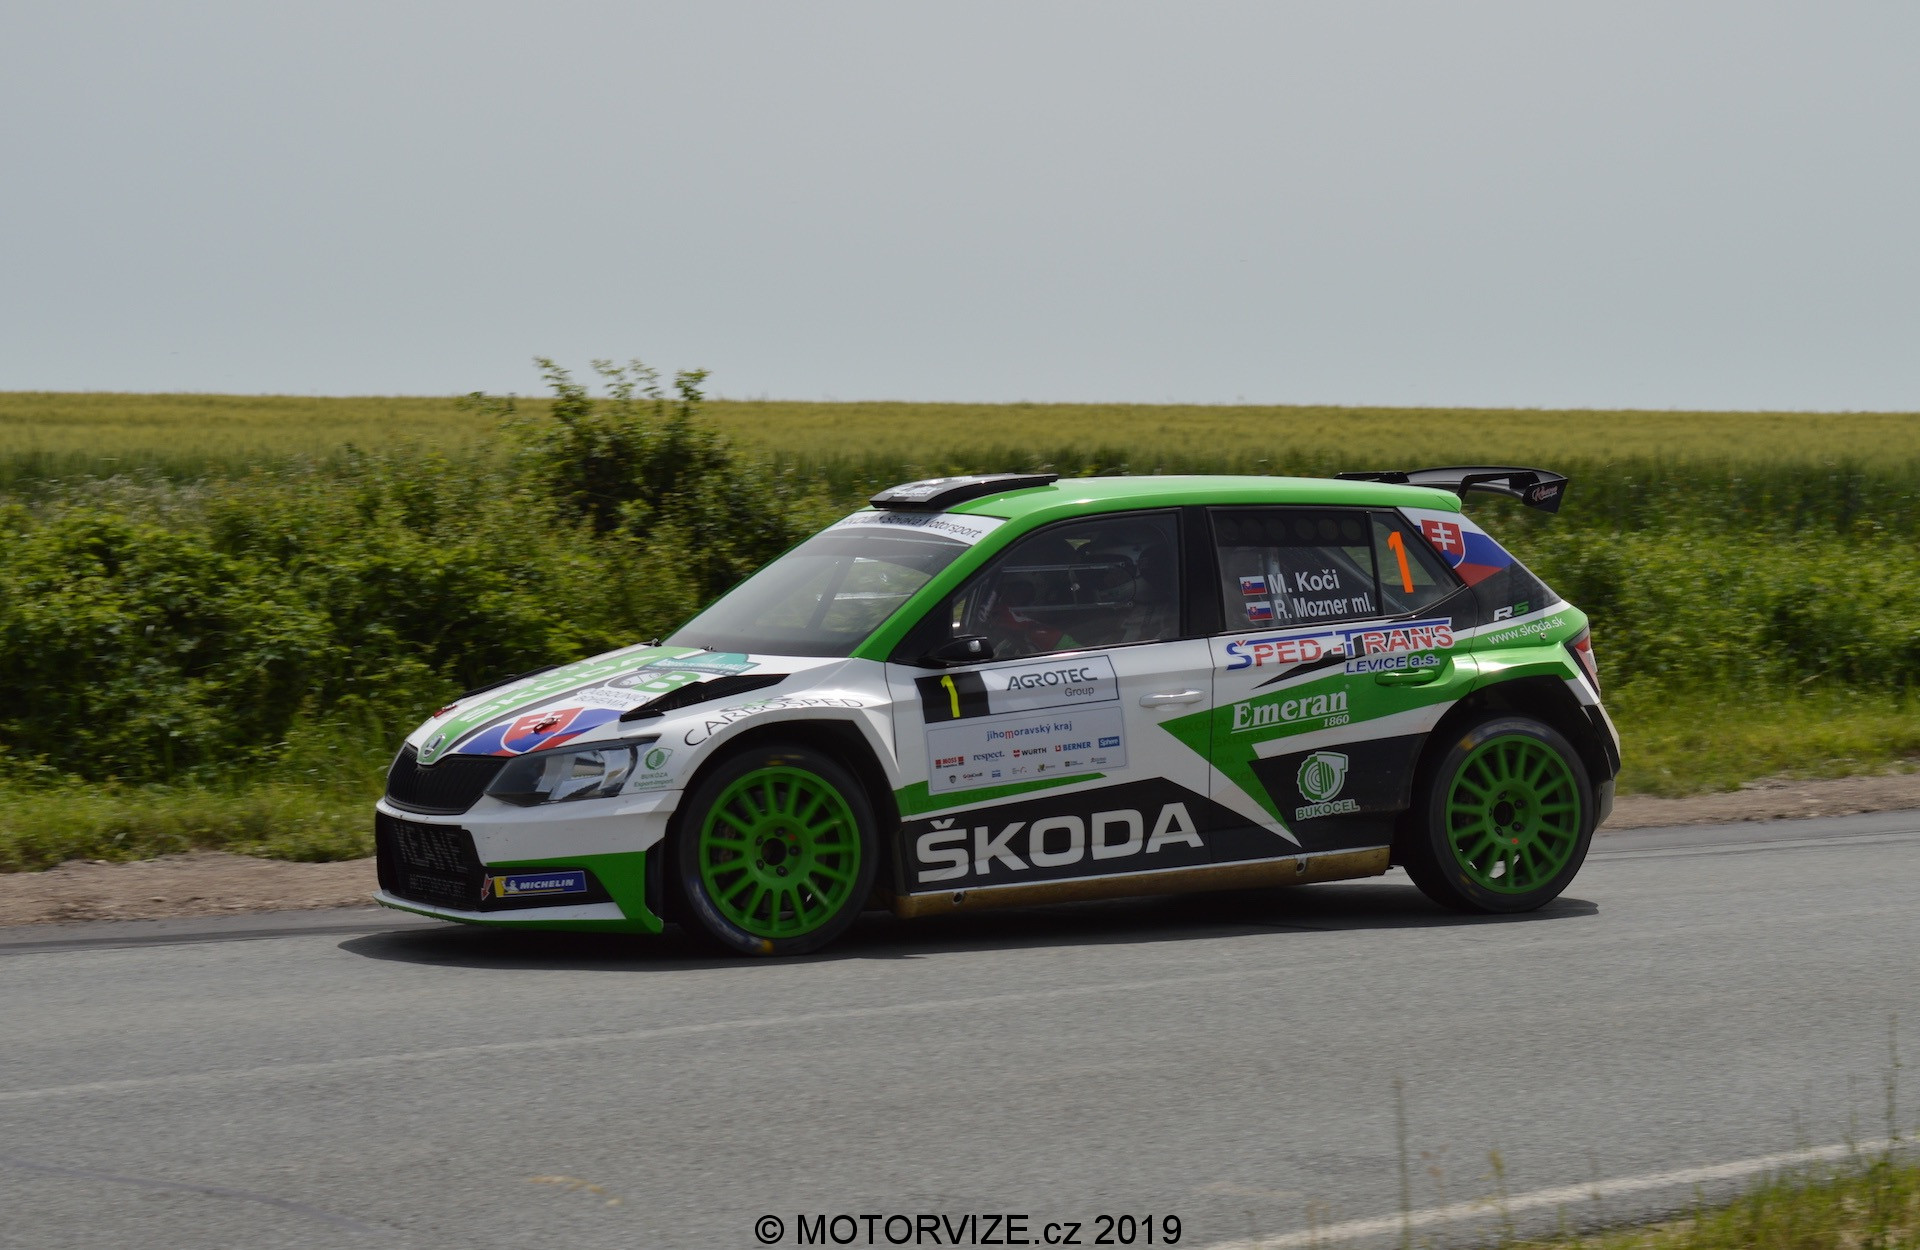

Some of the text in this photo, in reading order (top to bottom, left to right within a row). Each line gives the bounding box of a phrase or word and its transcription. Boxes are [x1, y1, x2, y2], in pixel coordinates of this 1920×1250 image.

[1387, 531, 1414, 594] 1
[1268, 569, 1340, 594] M. Koči
[1275, 592, 1376, 619] R. Mozner ml.
[1487, 616, 1566, 645] www.skoda.sk
[1346, 654, 1439, 674] LEVICE a.s.
[1006, 667, 1098, 691] AGROTEC
[940, 674, 961, 718] 1
[1064, 685, 1095, 698] Group
[684, 697, 864, 747] CARBOSPED
[1232, 690, 1349, 731] Emeran
[1323, 714, 1350, 728] 1860
[987, 721, 1073, 741] jihomoravský kraj
[1062, 741, 1092, 751] BERNER
[1297, 800, 1359, 820] BUKOCEL
[916, 801, 1204, 883] ŠKODA
[519, 879, 575, 890] MICHELIN
